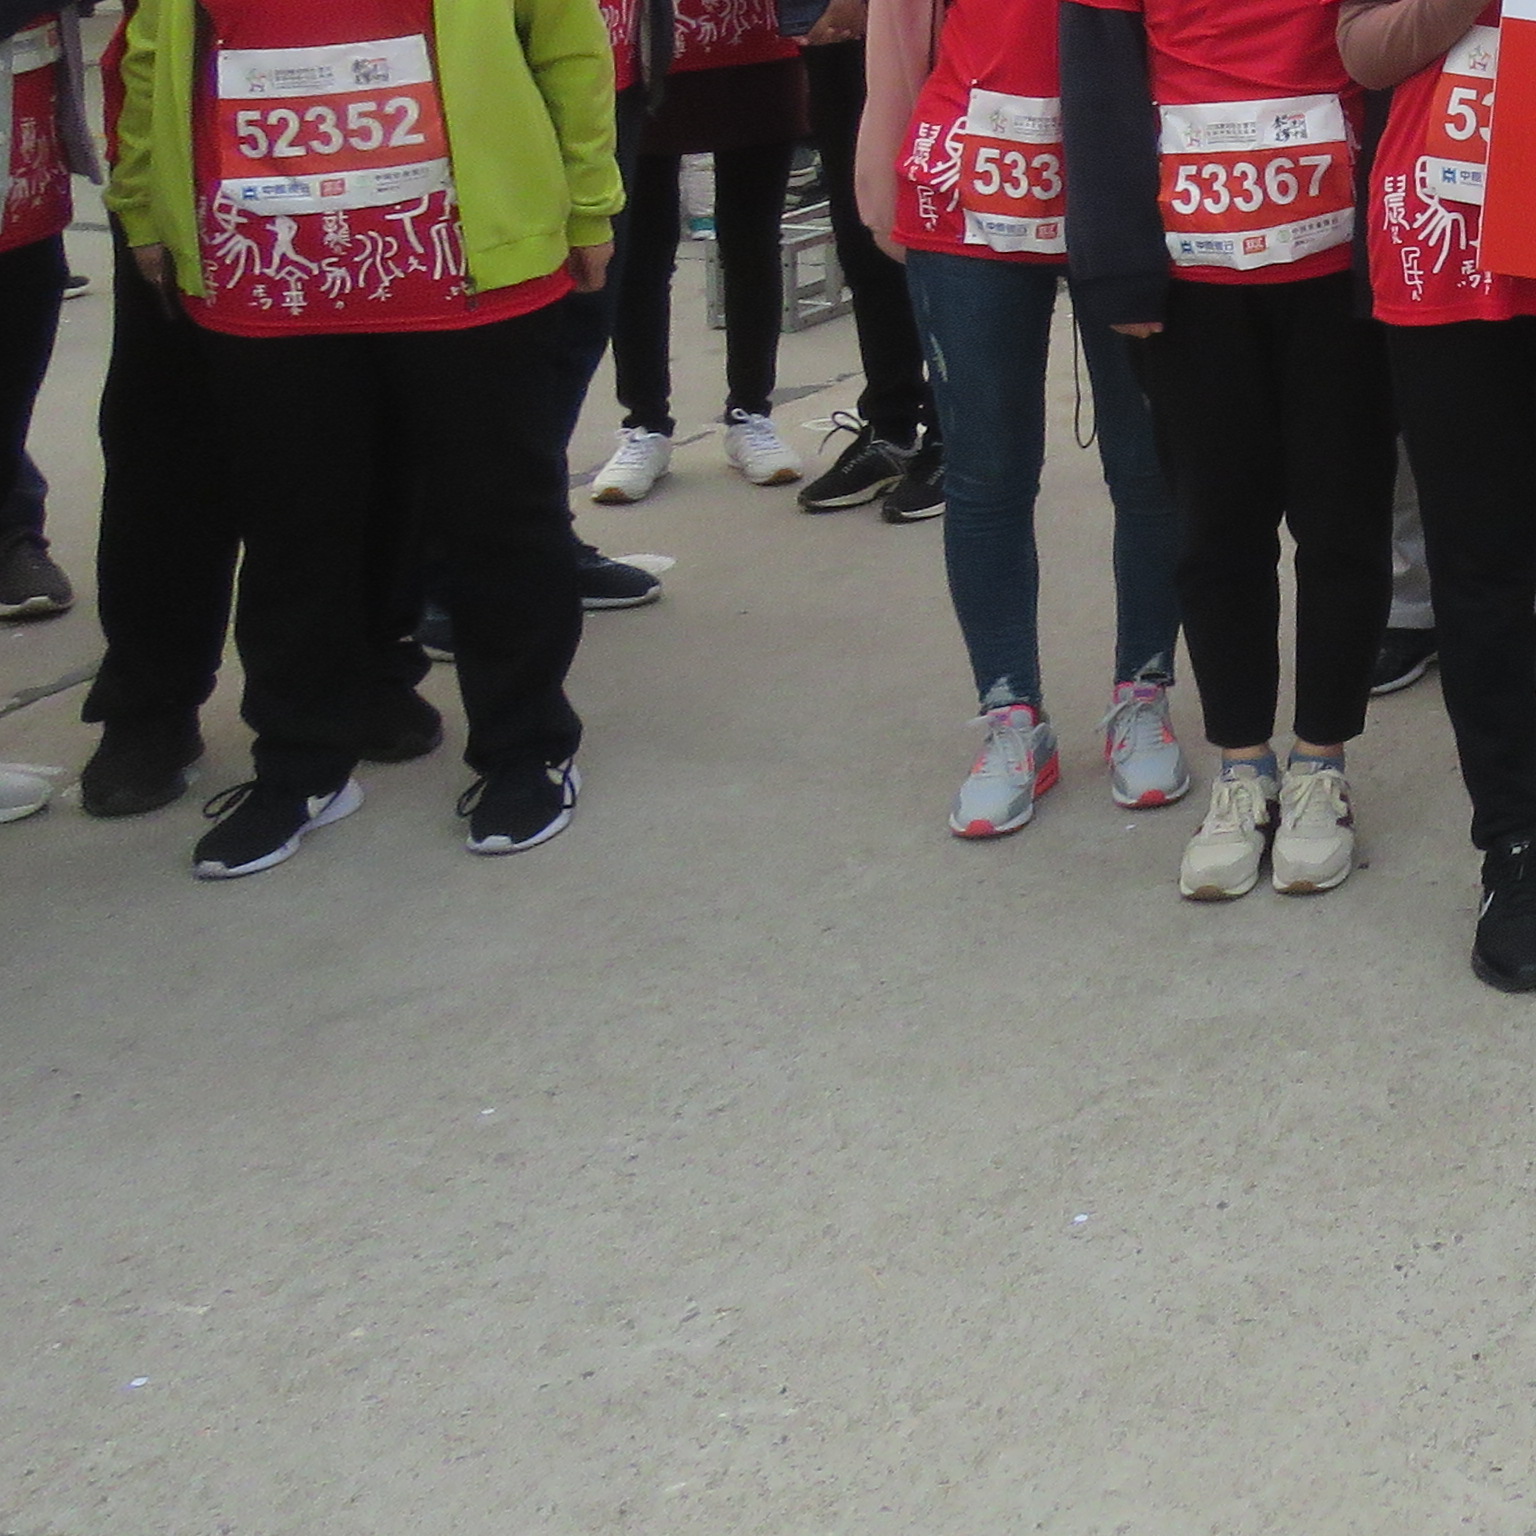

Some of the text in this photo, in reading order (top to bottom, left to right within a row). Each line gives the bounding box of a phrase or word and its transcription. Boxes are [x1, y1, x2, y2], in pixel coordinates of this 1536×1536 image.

[235, 96, 426, 159] 52352
[972, 146, 1063, 201] 533
[1170, 153, 1334, 216] 53367
